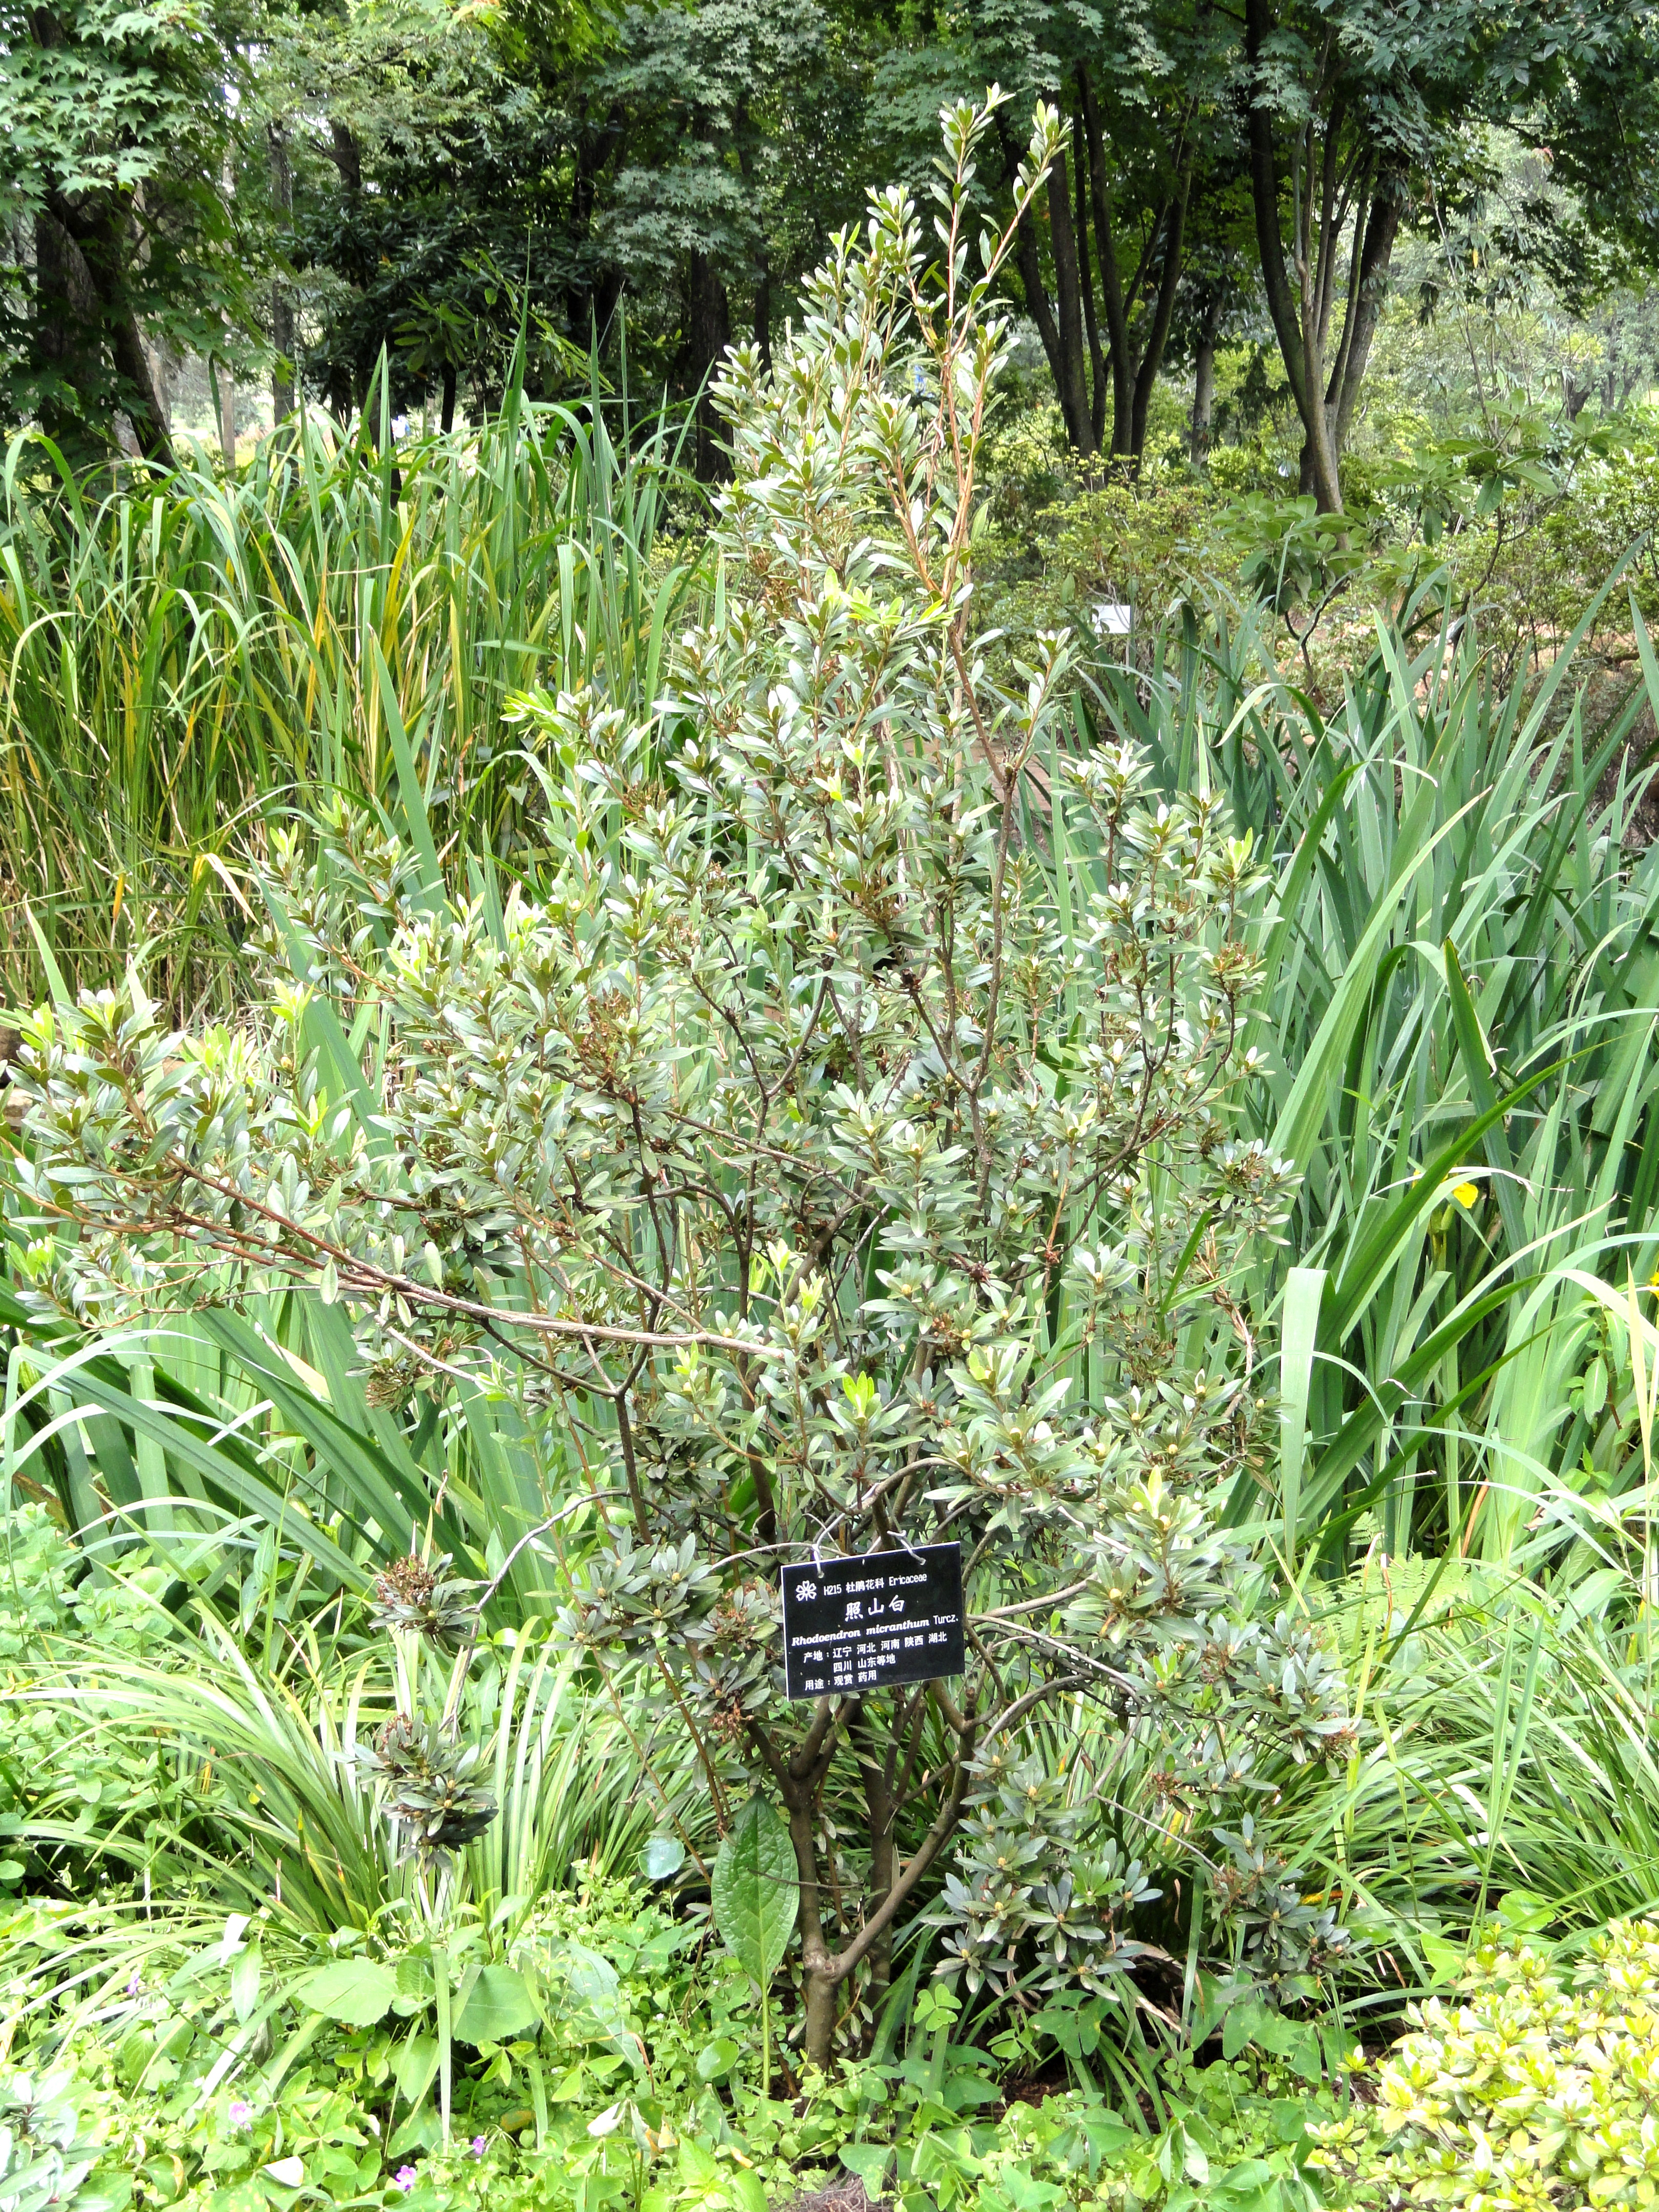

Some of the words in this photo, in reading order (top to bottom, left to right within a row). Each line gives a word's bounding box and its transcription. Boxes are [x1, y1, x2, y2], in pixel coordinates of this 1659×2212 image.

[824, 1584, 842, 1596] H215
[846, 1577, 884, 1593] 杜鹃花科
[889, 1573, 927, 1586] Ericaceae
[845, 1594, 905, 1622] 照山白
[792, 1629, 861, 1646] Rhodoendron
[866, 1619, 929, 1635] micranthum
[933, 1614, 959, 1625] Turcz.
[857, 1643, 876, 1654] 河北
[881, 1639, 900, 1651] 河南
[904, 1635, 923, 1648] 陕西
[928, 1631, 947, 1643] 湖北
[834, 1662, 852, 1673] 四川
[858, 1654, 896, 1668] 山东等地
[858, 1670, 877, 1682] 药用
